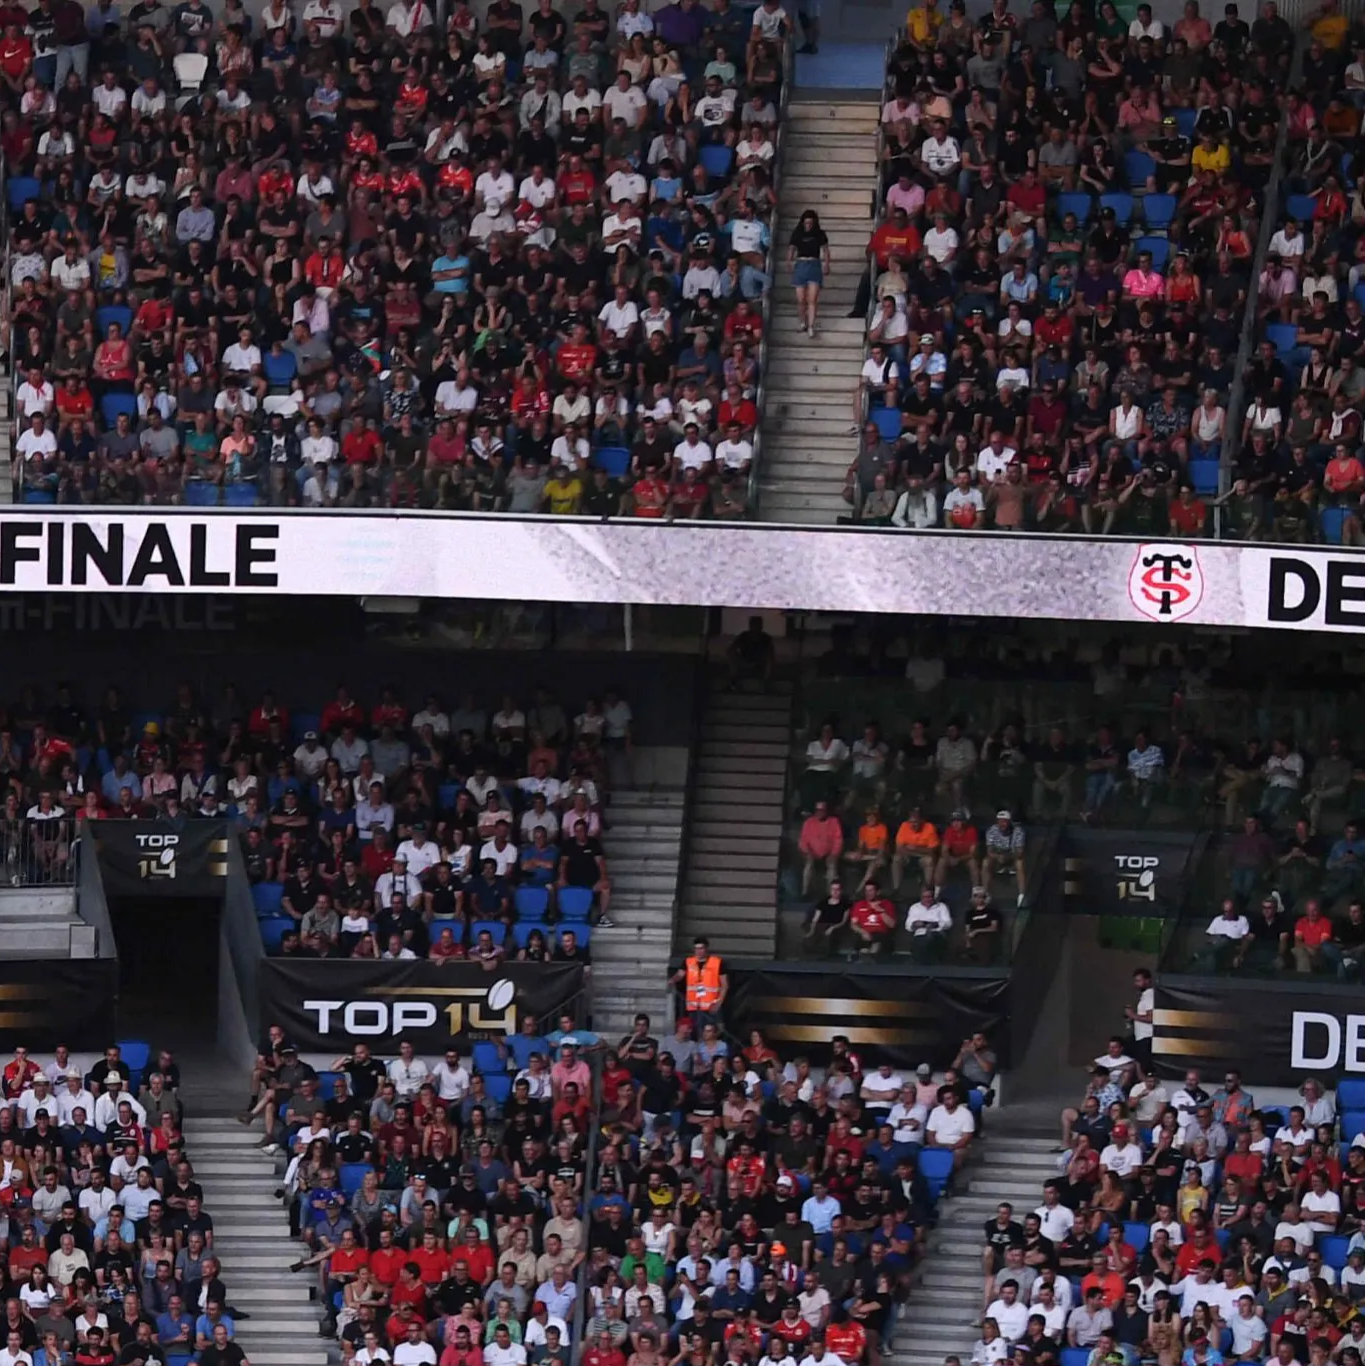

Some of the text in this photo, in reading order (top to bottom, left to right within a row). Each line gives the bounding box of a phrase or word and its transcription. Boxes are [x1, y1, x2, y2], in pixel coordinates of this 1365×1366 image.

[135, 835, 179, 847] TOP
[138, 861, 176, 879] 14
[1115, 856, 1159, 869] TOP
[1116, 881, 1155, 901] 14
